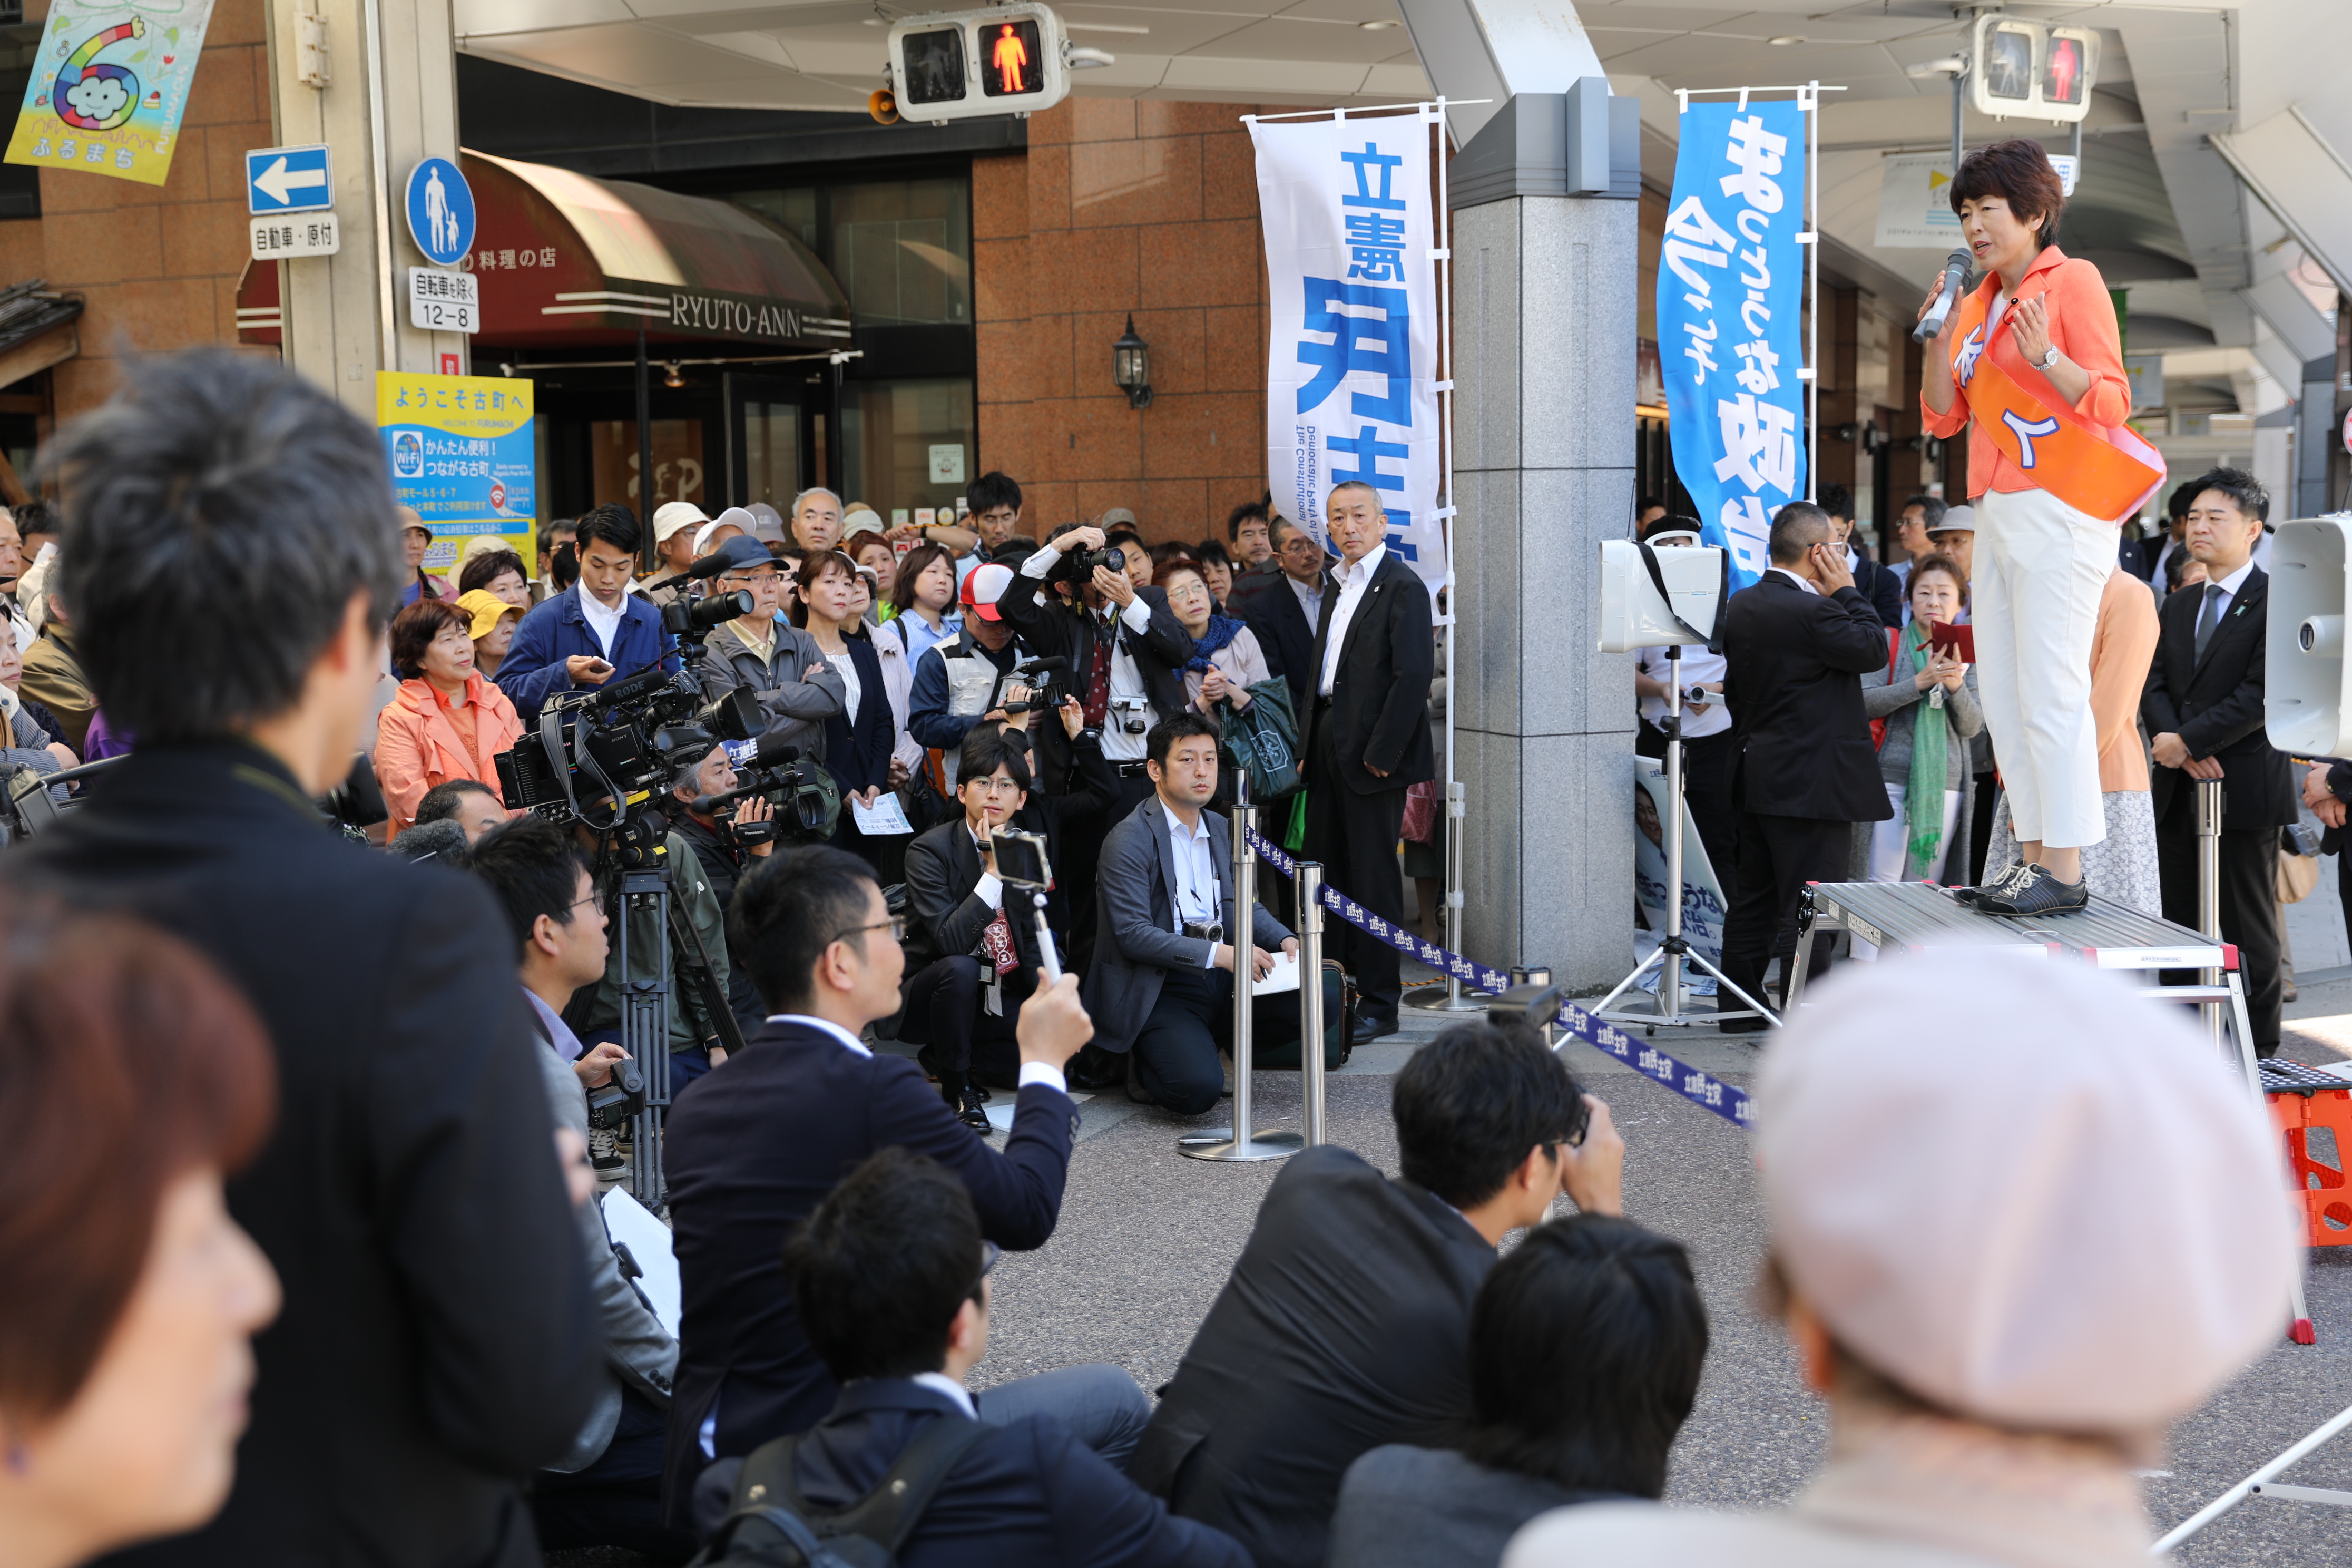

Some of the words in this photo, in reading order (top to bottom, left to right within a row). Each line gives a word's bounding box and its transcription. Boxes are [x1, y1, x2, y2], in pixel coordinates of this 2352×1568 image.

[155, 65, 188, 154] FURUMACHI
[31, 136, 135, 169] ふるまち
[257, 222, 332, 250] 自動車・原付
[416, 272, 474, 300] 自転車を除く
[672, 292, 800, 338] RYUTO-ANN
[396, 386, 524, 412] ようこそ古町へ
[477, 419, 514, 428] FURUMACHI
[425, 439, 496, 456] かんたん便利！
[426, 459, 489, 478] つながる古町
[1110, 609, 1118, 626] Nikon
[615, 680, 645, 699] RØDE
[611, 734, 628, 742] SONY
[1324, 889, 1341, 909] 立憲民主党
[1635, 871, 1722, 914] まっうな
[1346, 902, 1364, 923] 立憲民主党
[1369, 916, 1388, 937] 立憲民主党
[1394, 929, 1414, 951] 立憲民主党
[1420, 943, 1443, 965] 立憲民主党
[1450, 957, 1474, 979] 立憲民主党
[1482, 969, 1507, 993] 立憲民主党
[1559, 1003, 1587, 1032] 立憲民主党
[1596, 1025, 1628, 1056] 立憲民主党
[1638, 1048, 1673, 1081] 立憲民主党
[1684, 1073, 1722, 1106] 立憲民主党
